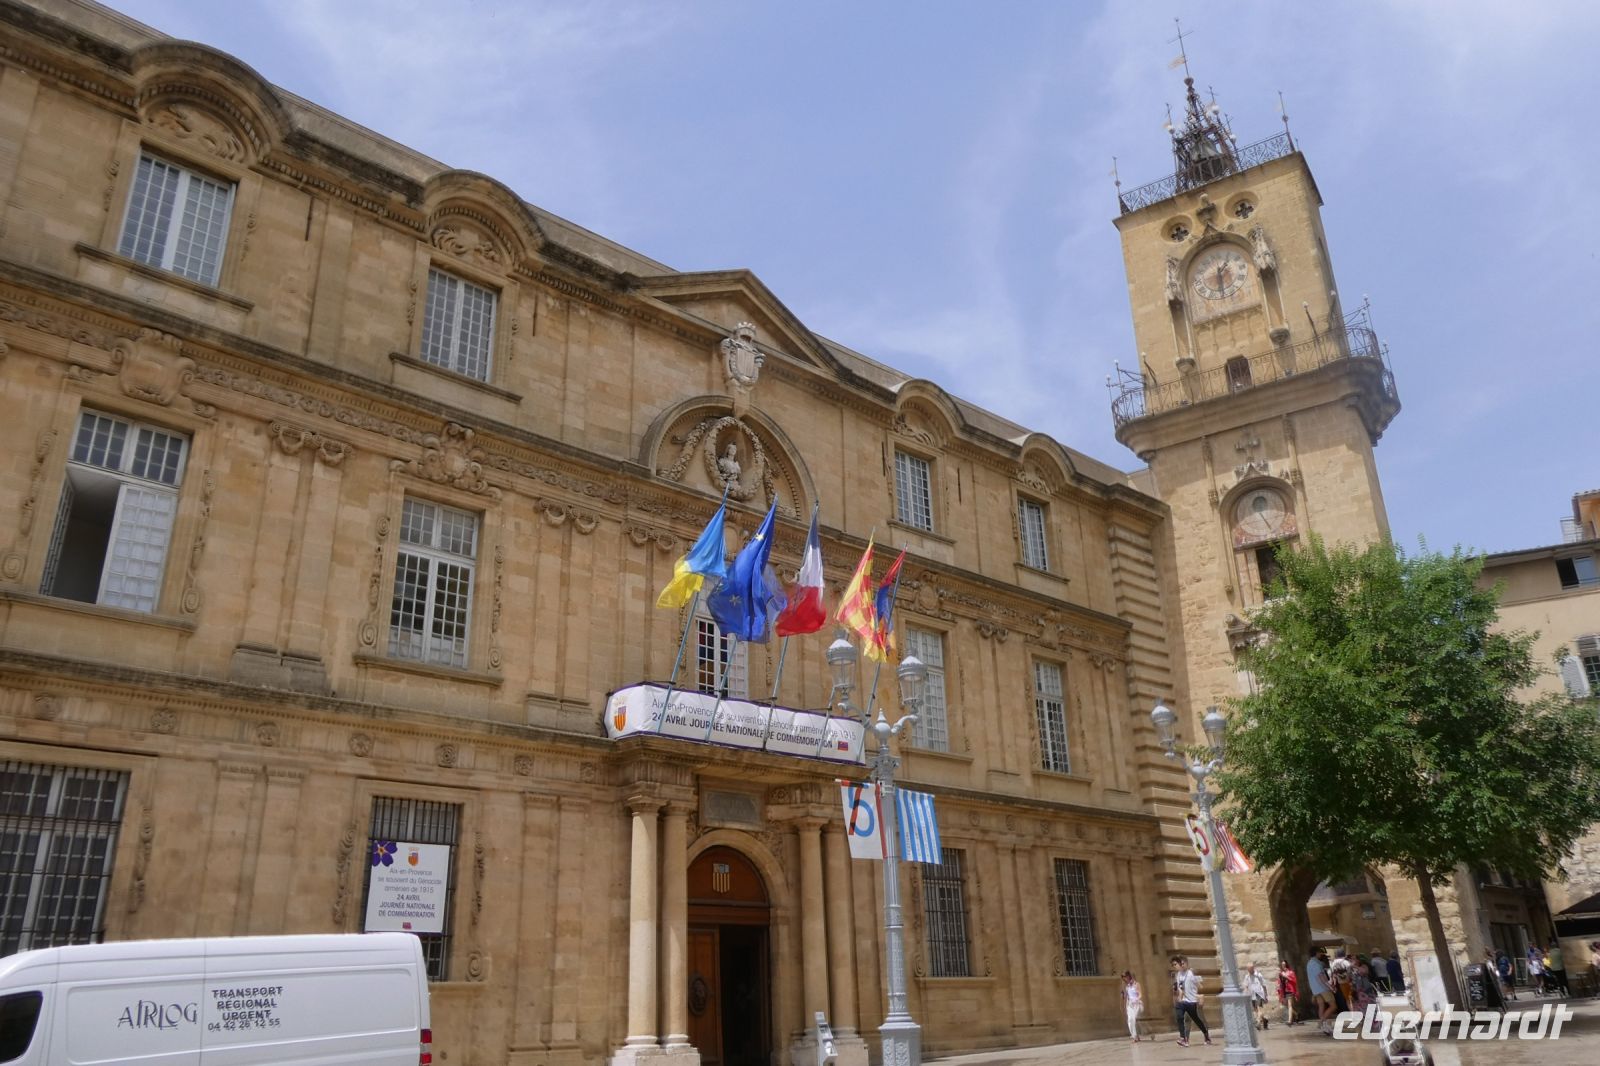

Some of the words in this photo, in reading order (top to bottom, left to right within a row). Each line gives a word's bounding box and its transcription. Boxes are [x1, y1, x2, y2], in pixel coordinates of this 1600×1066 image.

[666, 714, 687, 726] AVRIL
[726, 723, 764, 738] NATIONALE
[767, 731, 775, 740] DE
[379, 901, 405, 909] JOURNÉE
[406, 902, 436, 910] NATIONALE
[378, 909, 386, 917] DE
[212, 986, 283, 999] TRANSPORT
[216, 998, 277, 1010] REGIONAL
[117, 1000, 198, 1030] AIRLOG
[222, 1010, 271, 1021] URGENT
[208, 1022, 221, 1032] 04
[223, 1020, 237, 1030] 42
[254, 1018, 266, 1028] 12
